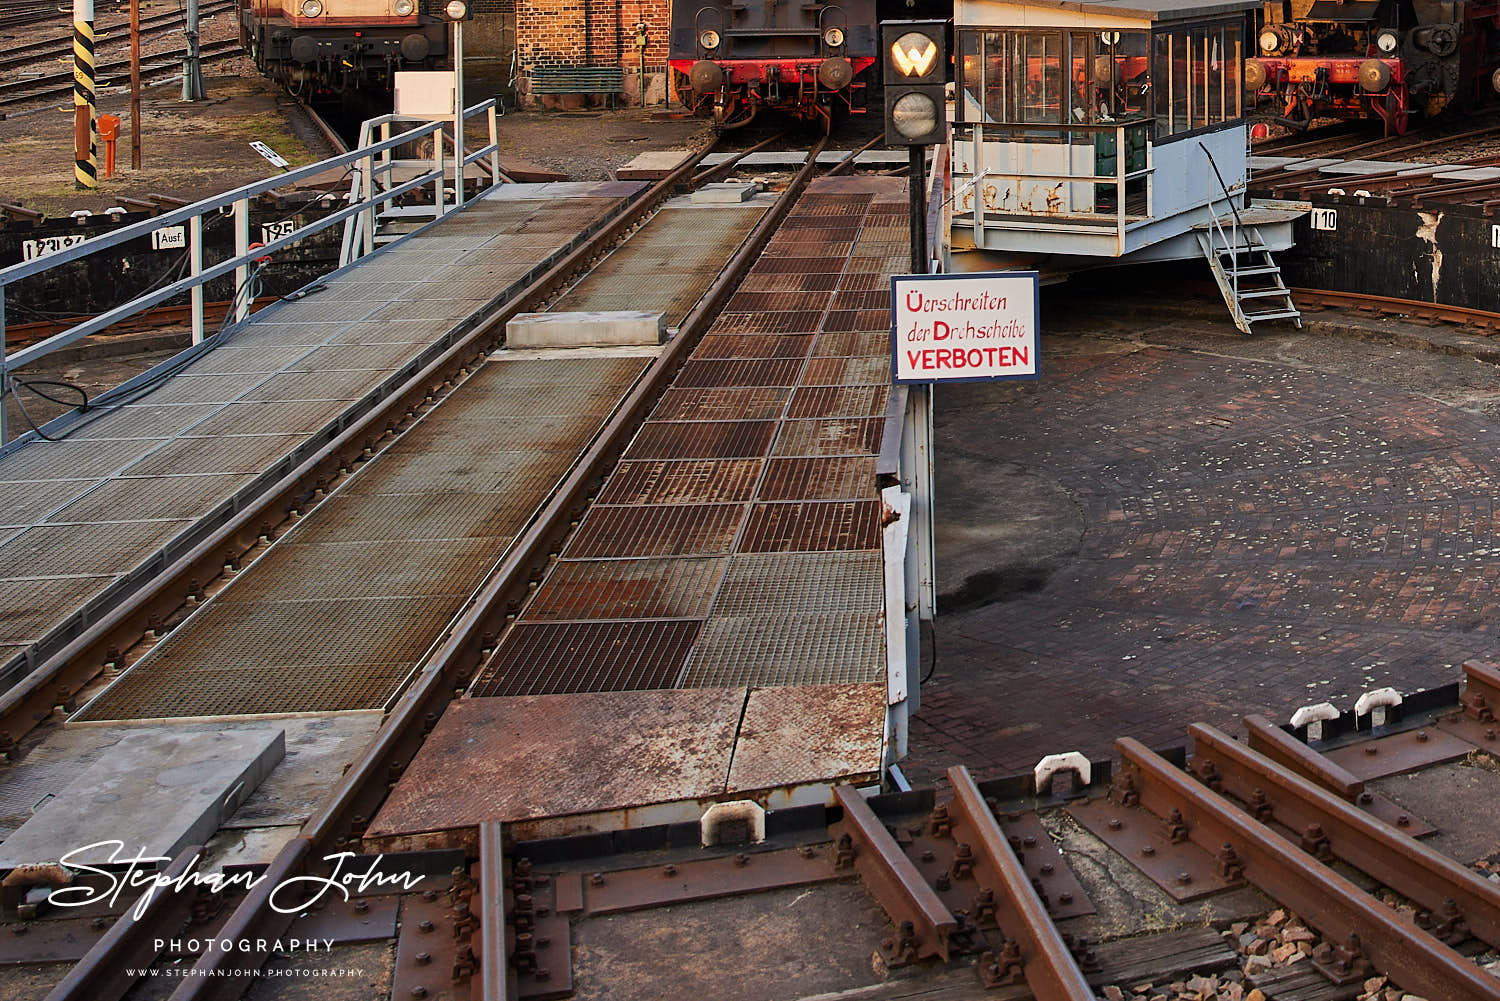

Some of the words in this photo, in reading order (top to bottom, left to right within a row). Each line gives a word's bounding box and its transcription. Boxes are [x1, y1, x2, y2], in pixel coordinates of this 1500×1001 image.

[891, 41, 937, 78] W
[907, 321, 931, 342] der
[907, 346, 1029, 370] VERBOTEN
